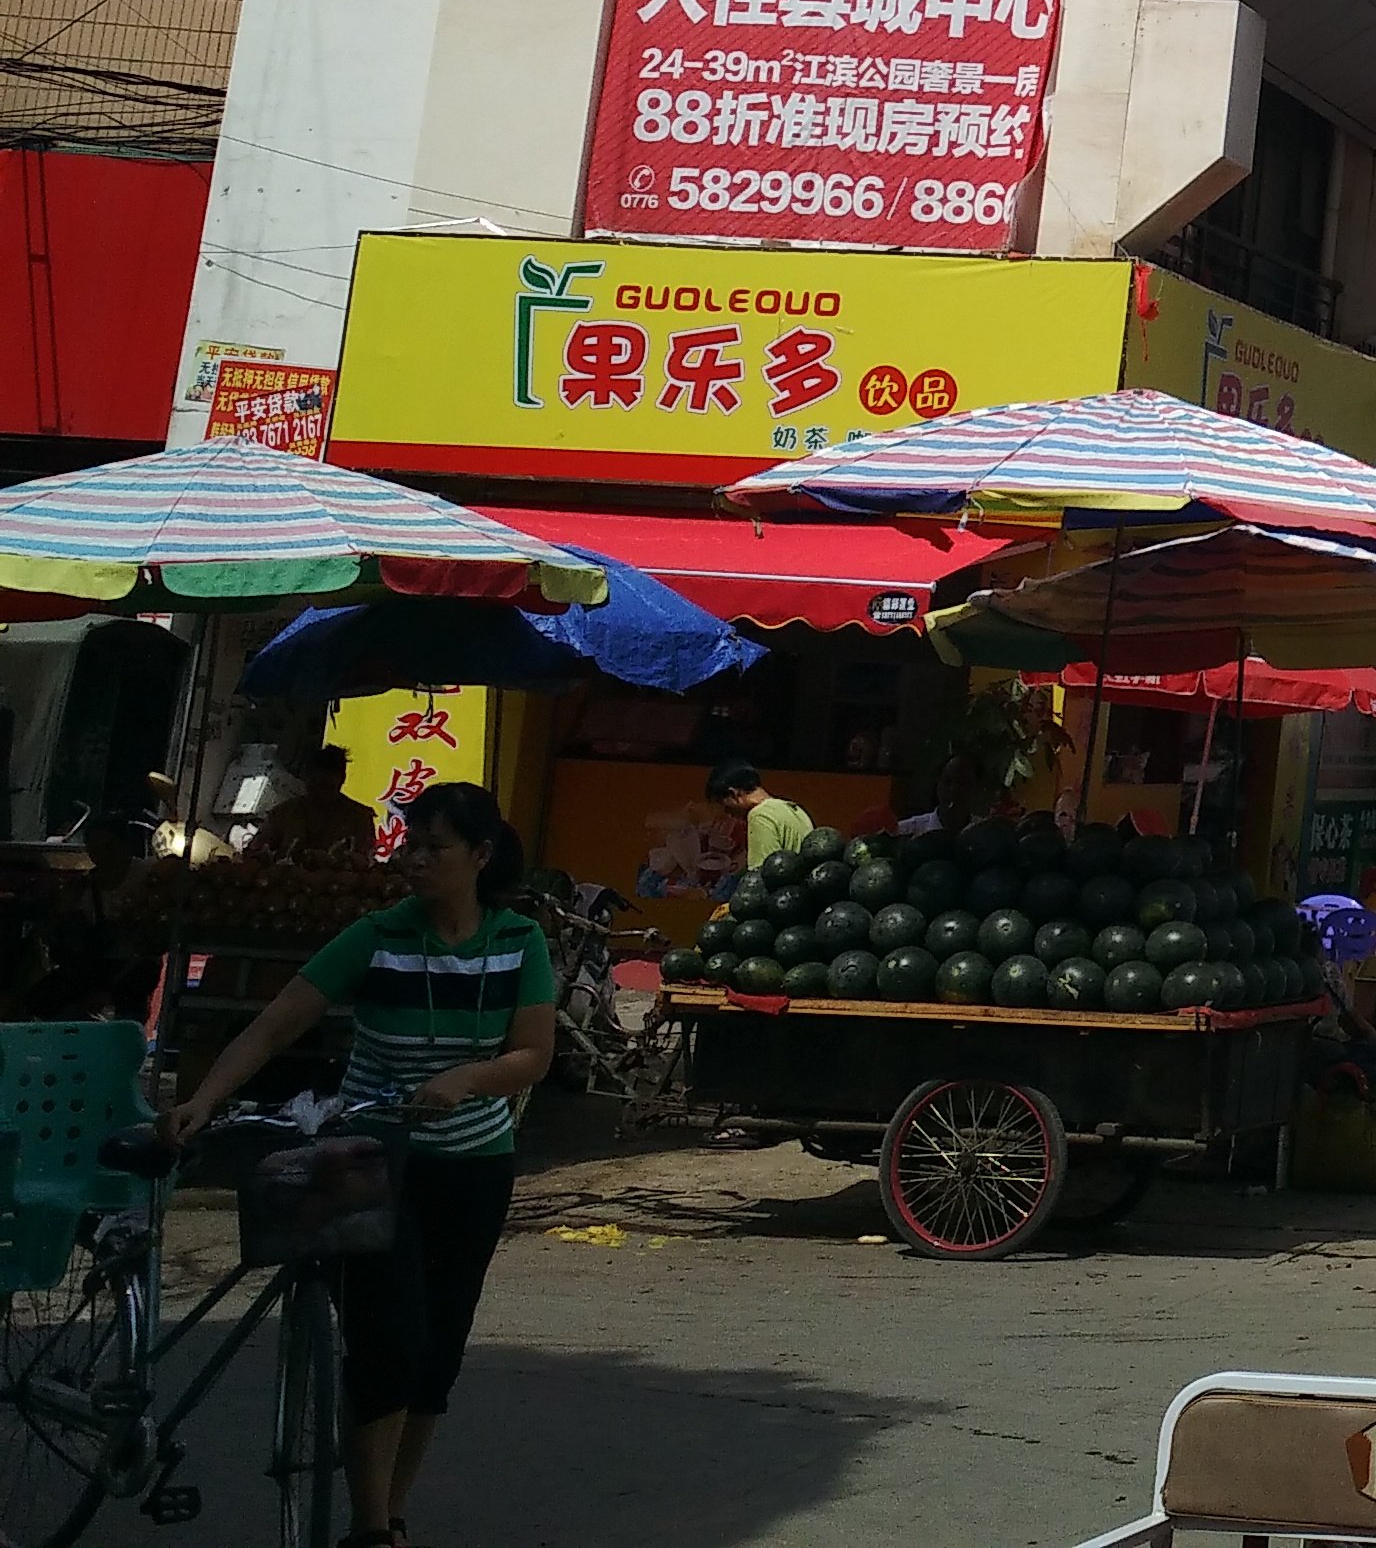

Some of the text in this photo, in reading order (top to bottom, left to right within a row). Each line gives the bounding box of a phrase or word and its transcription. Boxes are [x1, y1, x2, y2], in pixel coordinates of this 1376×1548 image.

[620, 193, 659, 210] 0776
[559, 320, 951, 419] 果乐多 饮品
[235, 390, 300, 423] 平安贷款
[293, 414, 323, 441] 2167
